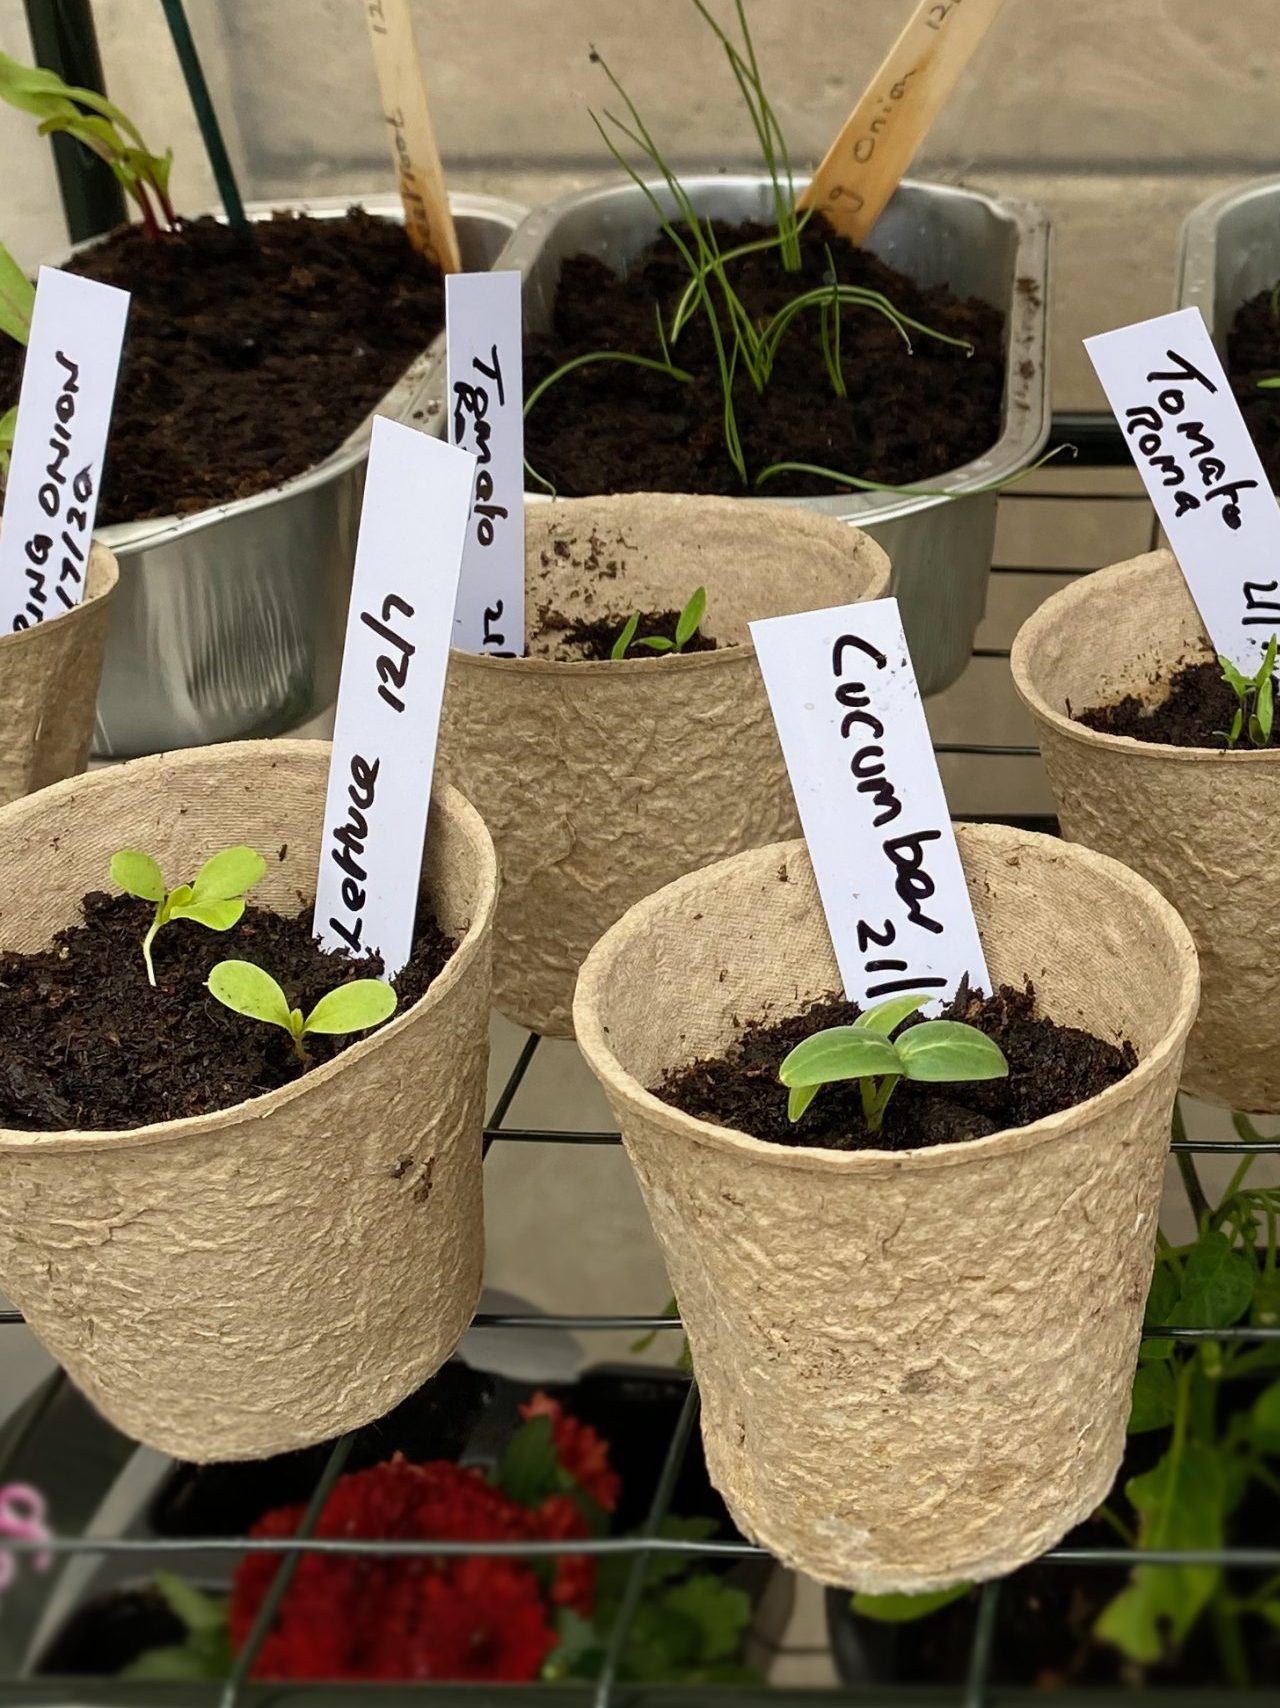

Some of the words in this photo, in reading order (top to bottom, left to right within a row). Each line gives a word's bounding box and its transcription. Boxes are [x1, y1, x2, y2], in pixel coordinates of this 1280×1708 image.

[37, 350, 80, 517] ONION
[472, 344, 508, 546] Tomato
[1125, 405, 1202, 518] Roma
[1146, 349, 1259, 530] Tomato
[360, 593, 416, 714] 12/7
[832, 633, 944, 934] Cucumber
